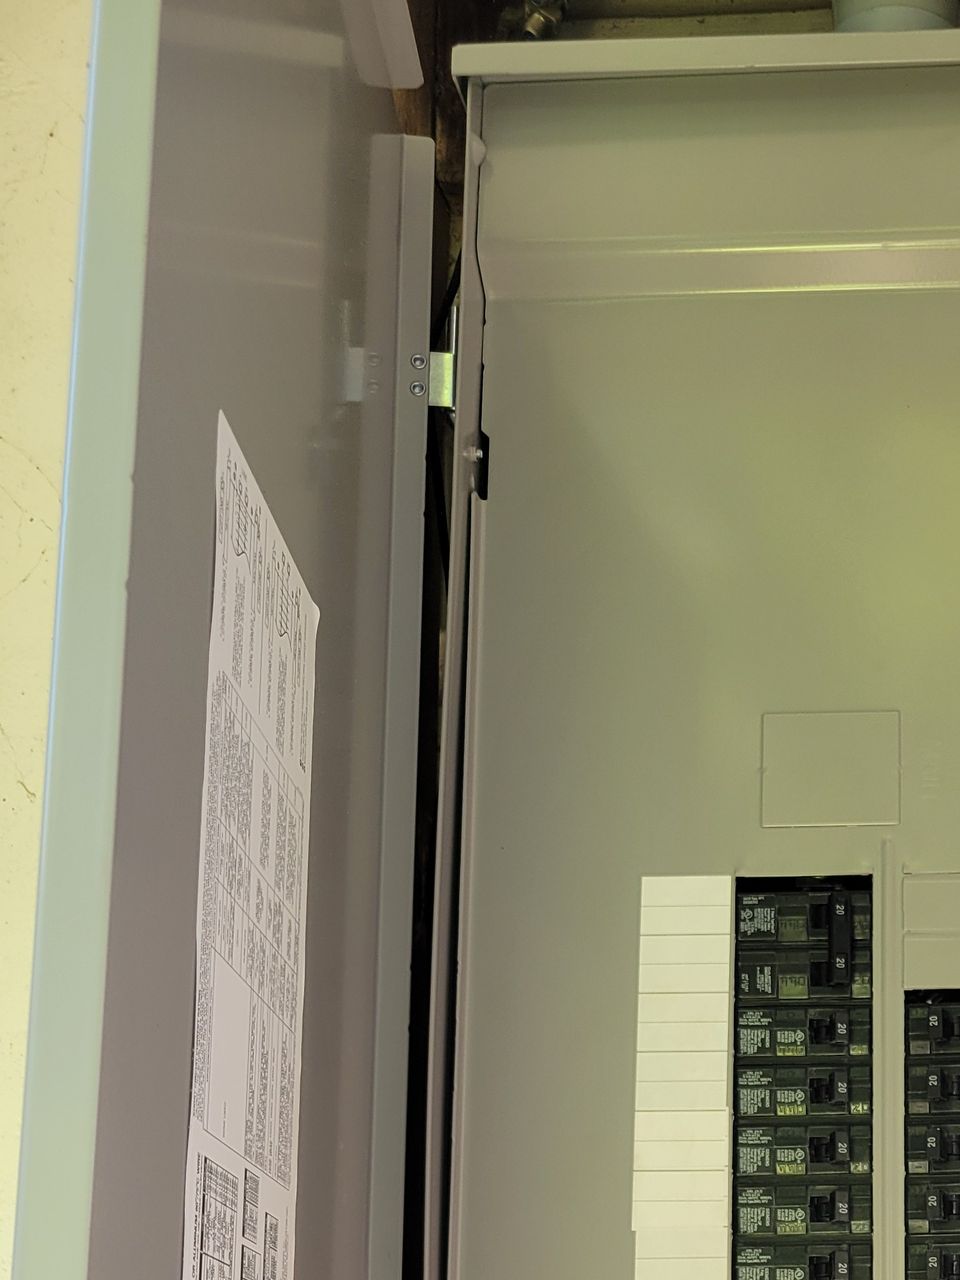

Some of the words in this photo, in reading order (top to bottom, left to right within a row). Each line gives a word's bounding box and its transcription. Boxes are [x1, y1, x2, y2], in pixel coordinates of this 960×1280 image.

[835, 904, 844, 915] 20
[835, 957, 845, 969] 20
[929, 1015, 938, 1027] 20
[837, 1023, 847, 1034] 20
[929, 1075, 938, 1086] 20
[837, 1082, 847, 1093] 20
[927, 1136, 936, 1148] 20
[838, 1142, 847, 1154] 20
[928, 1195, 937, 1207] 20
[839, 1203, 848, 1214] 20
[928, 1256, 938, 1268] 20
[838, 1263, 847, 1274] 20
